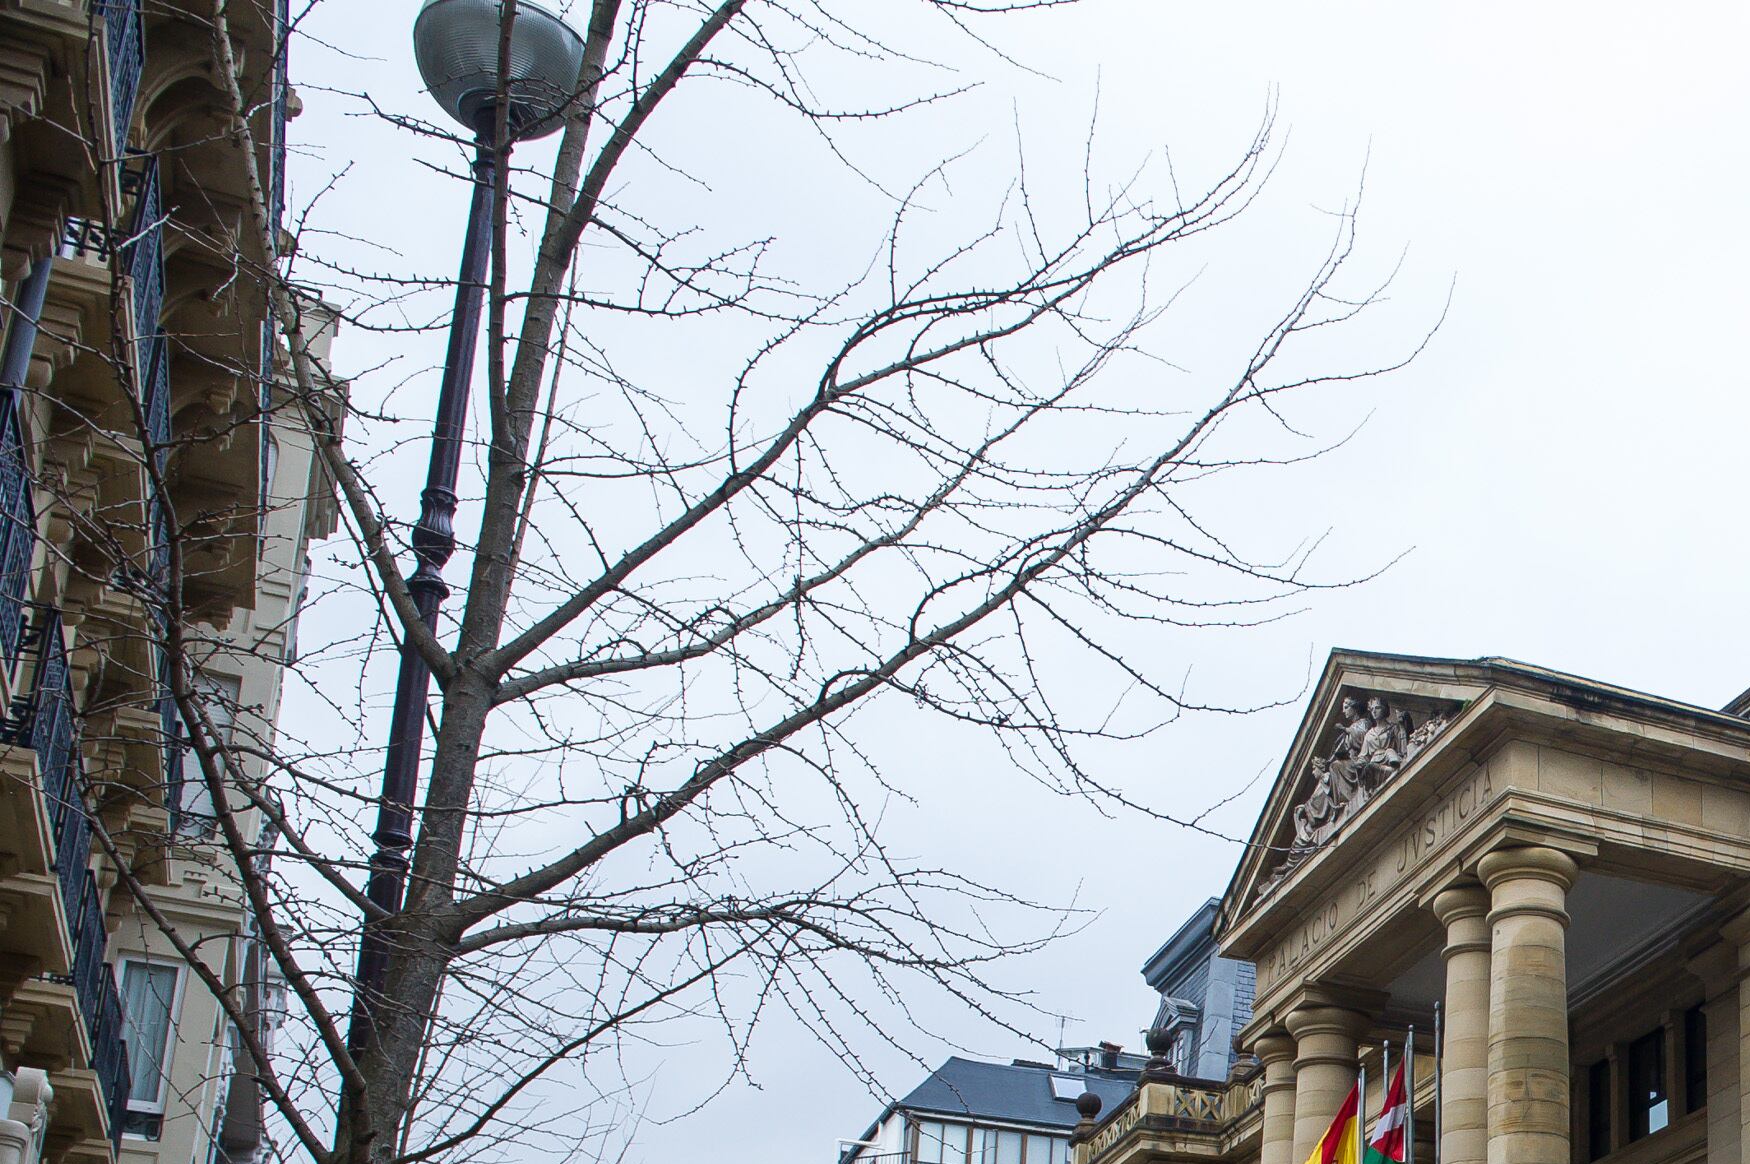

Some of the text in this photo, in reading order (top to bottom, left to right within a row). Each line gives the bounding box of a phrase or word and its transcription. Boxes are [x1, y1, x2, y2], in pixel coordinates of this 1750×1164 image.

[1265, 766, 1494, 985] PALACIO DE JVSTICIA
